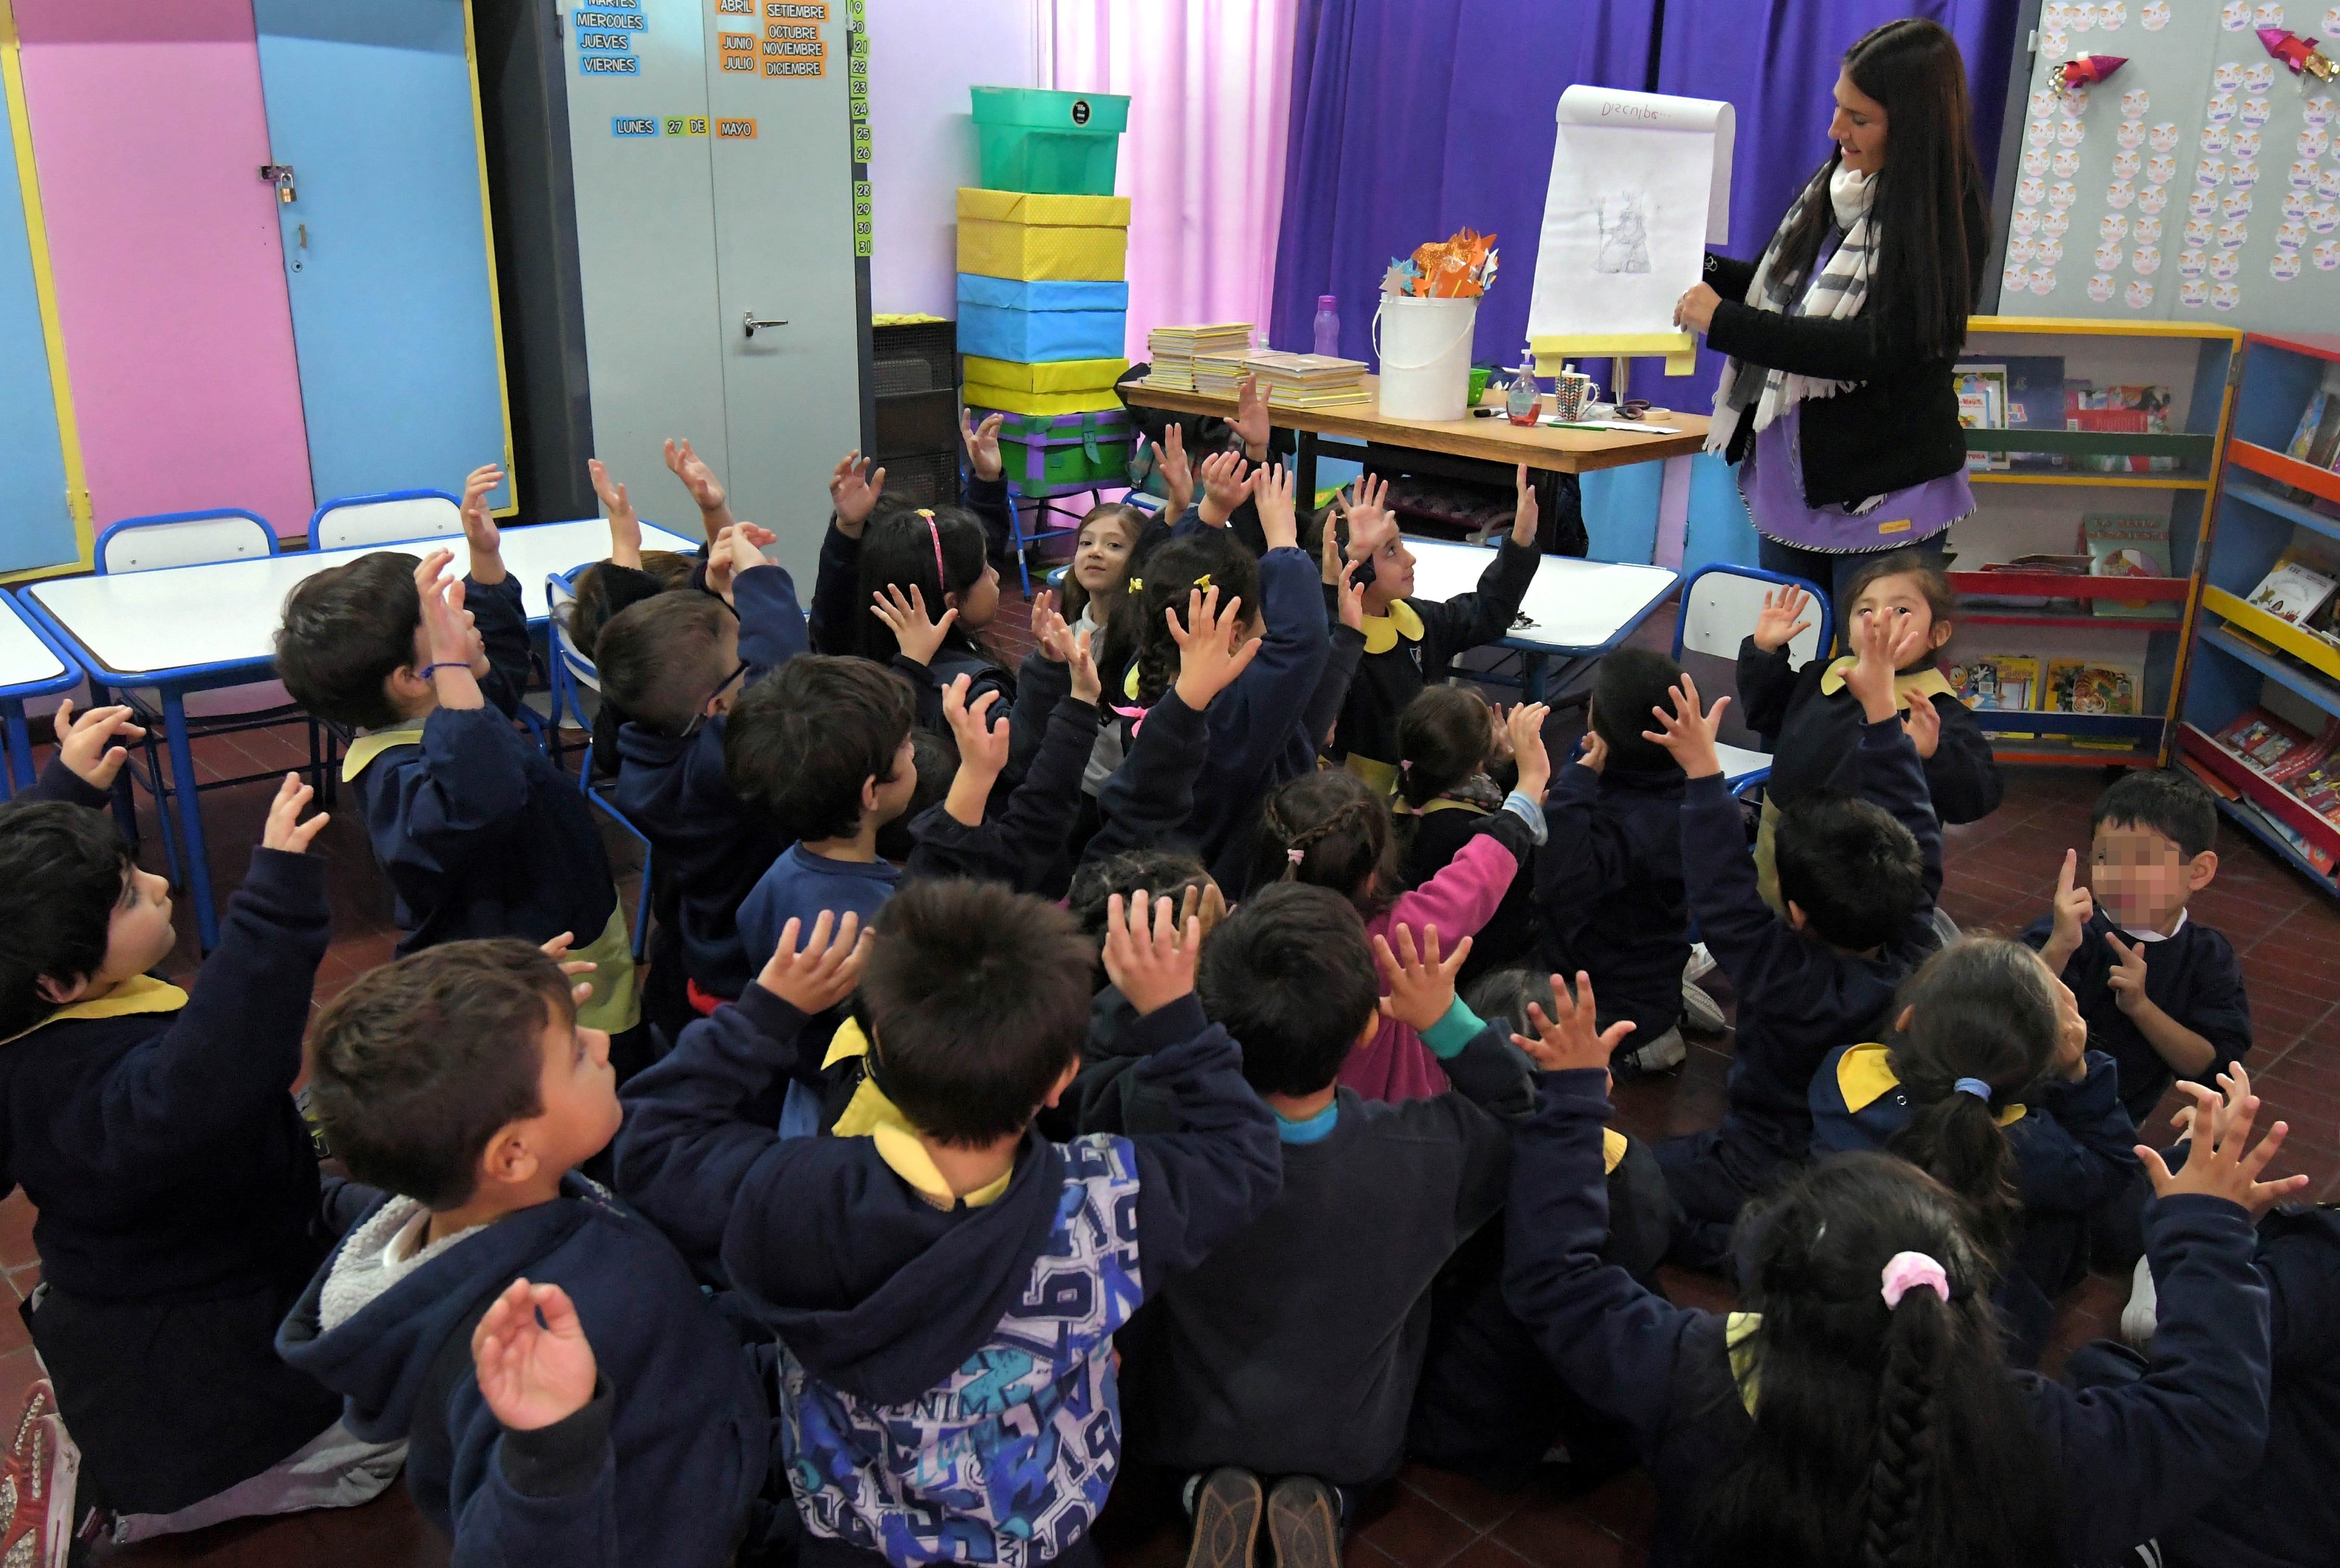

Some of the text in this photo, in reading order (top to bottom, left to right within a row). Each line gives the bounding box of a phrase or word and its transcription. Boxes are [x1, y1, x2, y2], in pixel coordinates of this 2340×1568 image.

[720, 0, 753, 13] ABRIL
[766, 3, 825, 19] SETIEMBRE
[850, 1, 862, 14] 19
[576, 12, 644, 30] MIERCOLES
[852, 21, 864, 33] 20
[769, 25, 817, 40] OCTUBRE
[581, 34, 628, 50] JUEVES
[723, 36, 753, 50] JUNIO
[855, 40, 867, 54] 21
[762, 42, 823, 57] NOVIEMBRE
[583, 58, 636, 72] VIERNES
[724, 57, 753, 71] JULIO
[766, 62, 821, 76] DICIEMBRE
[853, 61, 866, 73] 22
[853, 81, 867, 94] 23
[854, 102, 867, 116] 24
[617, 119, 751, 136] LUNES 27 DE MAYO
[856, 128, 869, 140] 25
[857, 147, 870, 159] 26
[857, 185, 870, 197] 28
[857, 203, 870, 215] 29
[857, 223, 870, 234] 30
[859, 240, 871, 253] 31
[878, 1392, 991, 1422] ENIM
